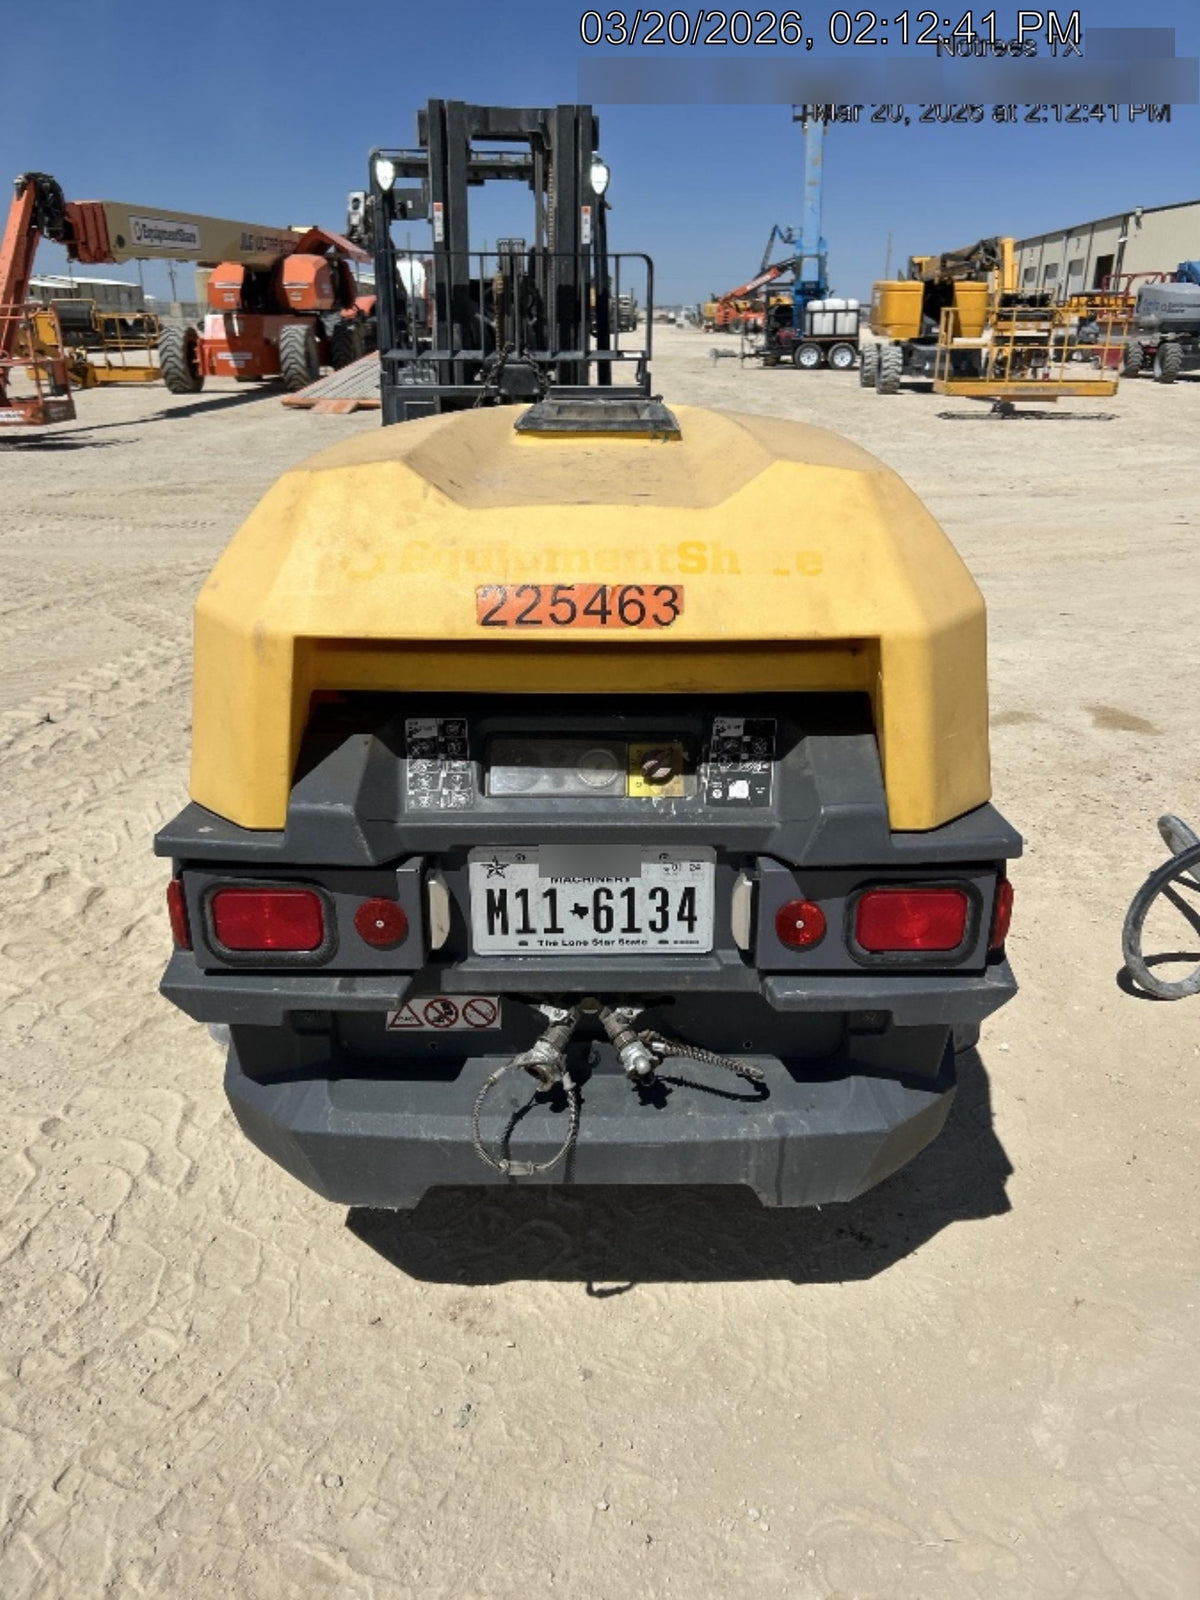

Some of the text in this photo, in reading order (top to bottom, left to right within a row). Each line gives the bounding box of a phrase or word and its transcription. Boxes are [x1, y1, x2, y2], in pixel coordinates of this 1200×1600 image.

[481, 584, 681, 627] 225463
[593, 887, 698, 934] 6134
[537, 939, 559, 947] The
[561, 939, 589, 947] Lone
[591, 938, 616, 947] Star
